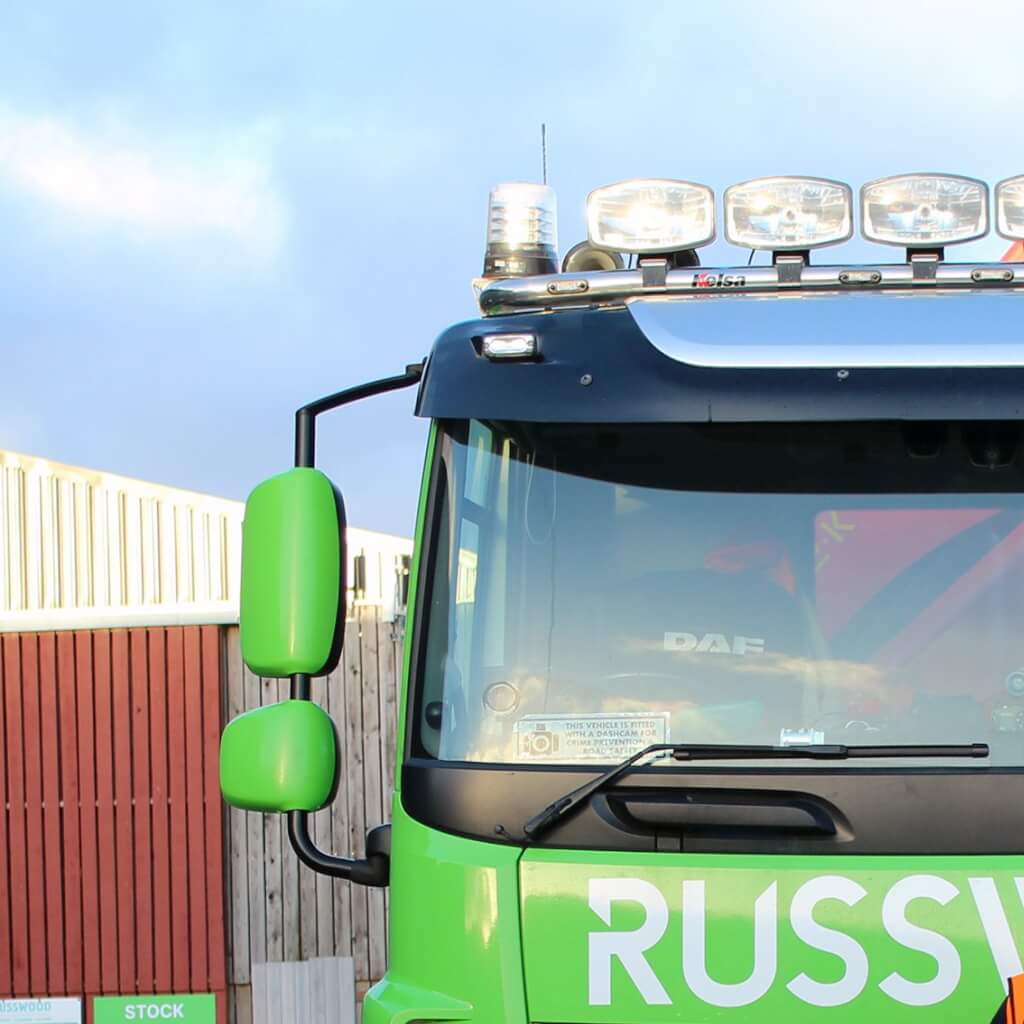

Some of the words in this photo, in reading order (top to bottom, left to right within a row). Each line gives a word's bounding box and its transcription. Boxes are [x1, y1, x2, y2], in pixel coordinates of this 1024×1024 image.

[663, 631, 765, 655] DAF
[565, 722, 584, 730] THIS
[586, 721, 619, 730] VEHICLE
[620, 721, 629, 729] IS
[630, 721, 656, 729] FITTED
[596, 730, 639, 738] DASHCAM
[640, 730, 657, 738] FOR
[0, 1001, 51, 1013] USSWOOD
[124, 1003, 185, 1019] STOCK
